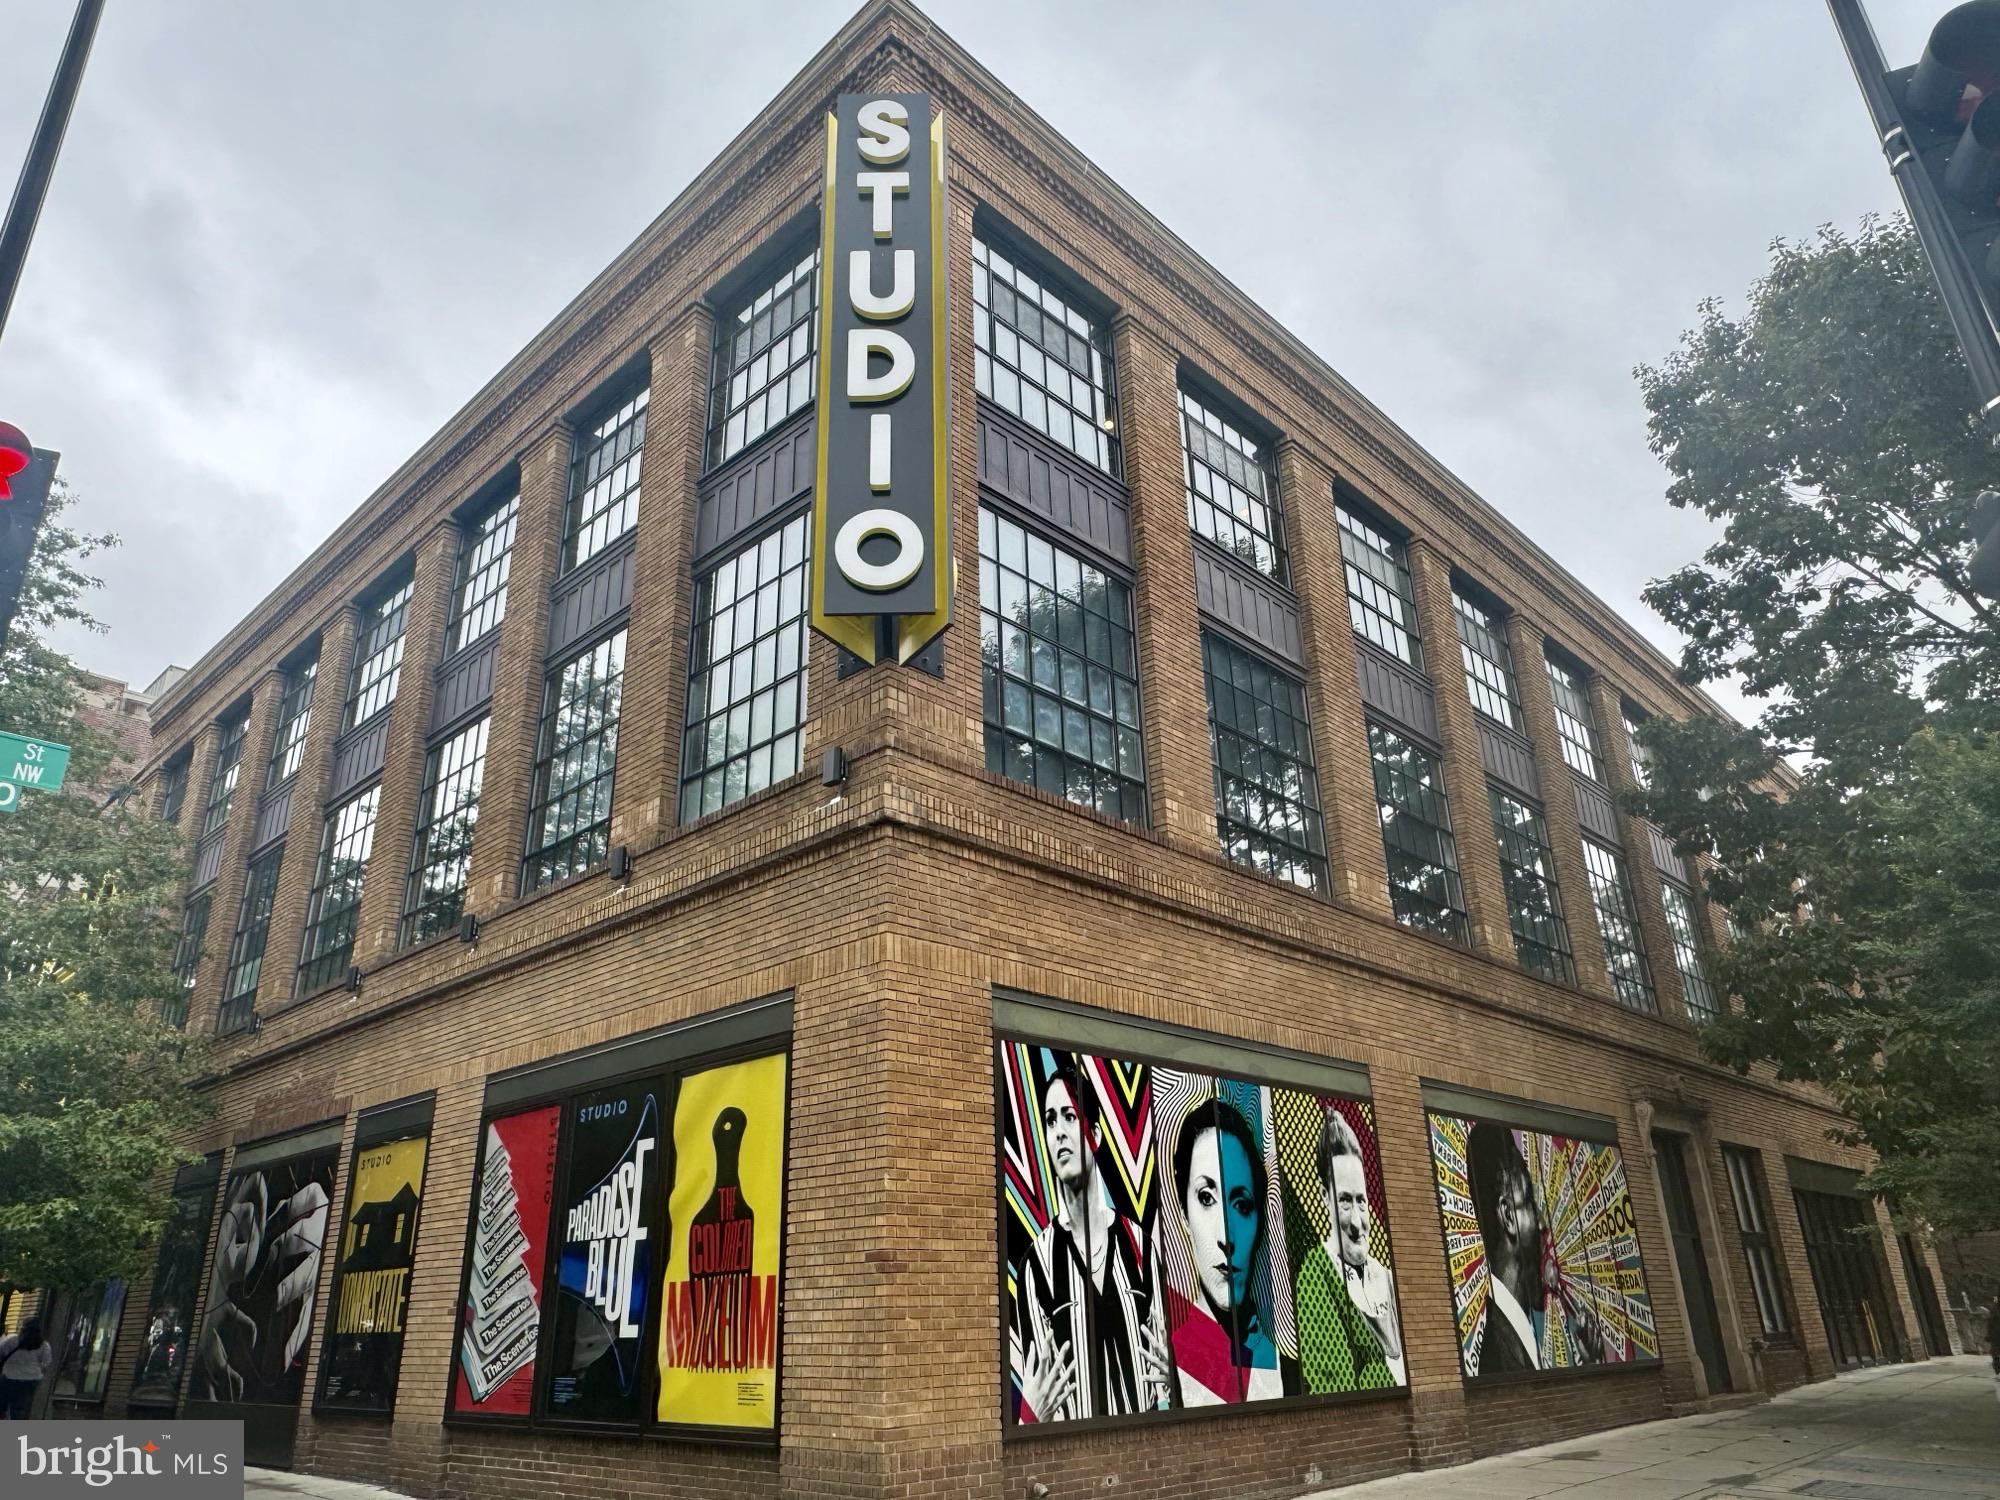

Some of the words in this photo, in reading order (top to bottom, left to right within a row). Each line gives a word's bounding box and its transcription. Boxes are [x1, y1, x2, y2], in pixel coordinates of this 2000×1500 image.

[834, 99, 925, 592] STUDIO
[12, 762, 45, 784] NW
[23, 743, 46, 762] St
[580, 1099, 627, 1123] STUDIO
[361, 1153, 392, 1171] STUDIO
[567, 1137, 655, 1243] PARADISE
[718, 1186, 737, 1221] THE
[692, 1219, 753, 1275] COLORED
[337, 1267, 409, 1334] DOWNSTATE
[482, 1293, 498, 1311] The
[494, 1267, 527, 1299] Scenarios
[585, 1228, 648, 1339] BLUE
[482, 1327, 498, 1343] The
[495, 1297, 531, 1331] Scenarios
[666, 1275, 777, 1370] MUSEUM
[484, 1360, 503, 1381] The
[500, 1325, 540, 1362] Scenarios
